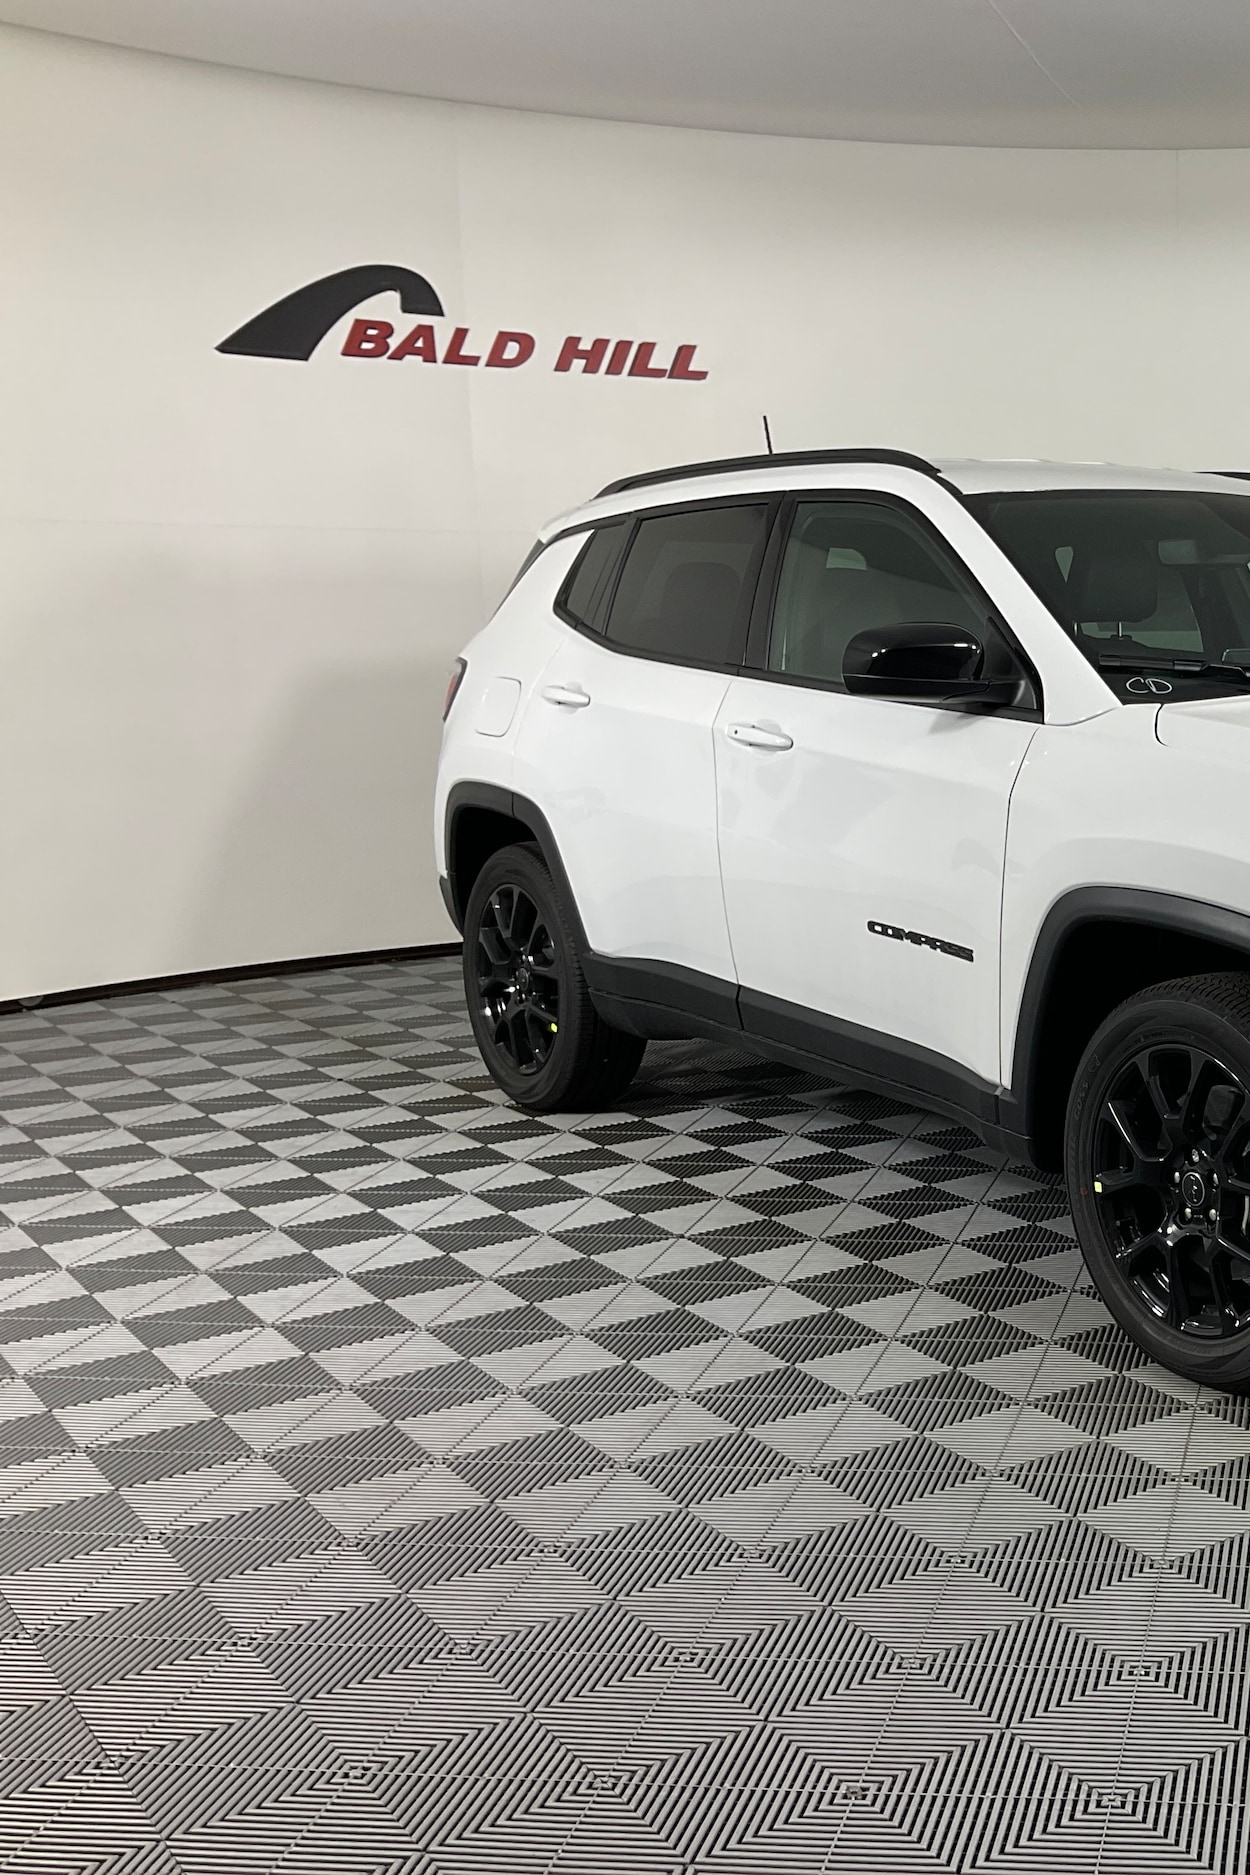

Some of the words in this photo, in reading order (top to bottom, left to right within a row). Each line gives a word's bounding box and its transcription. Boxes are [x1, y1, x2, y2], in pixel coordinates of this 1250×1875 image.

[341, 319, 535, 368] BALD
[554, 336, 709, 380] HILL
[867, 920, 974, 963] COMPASS
